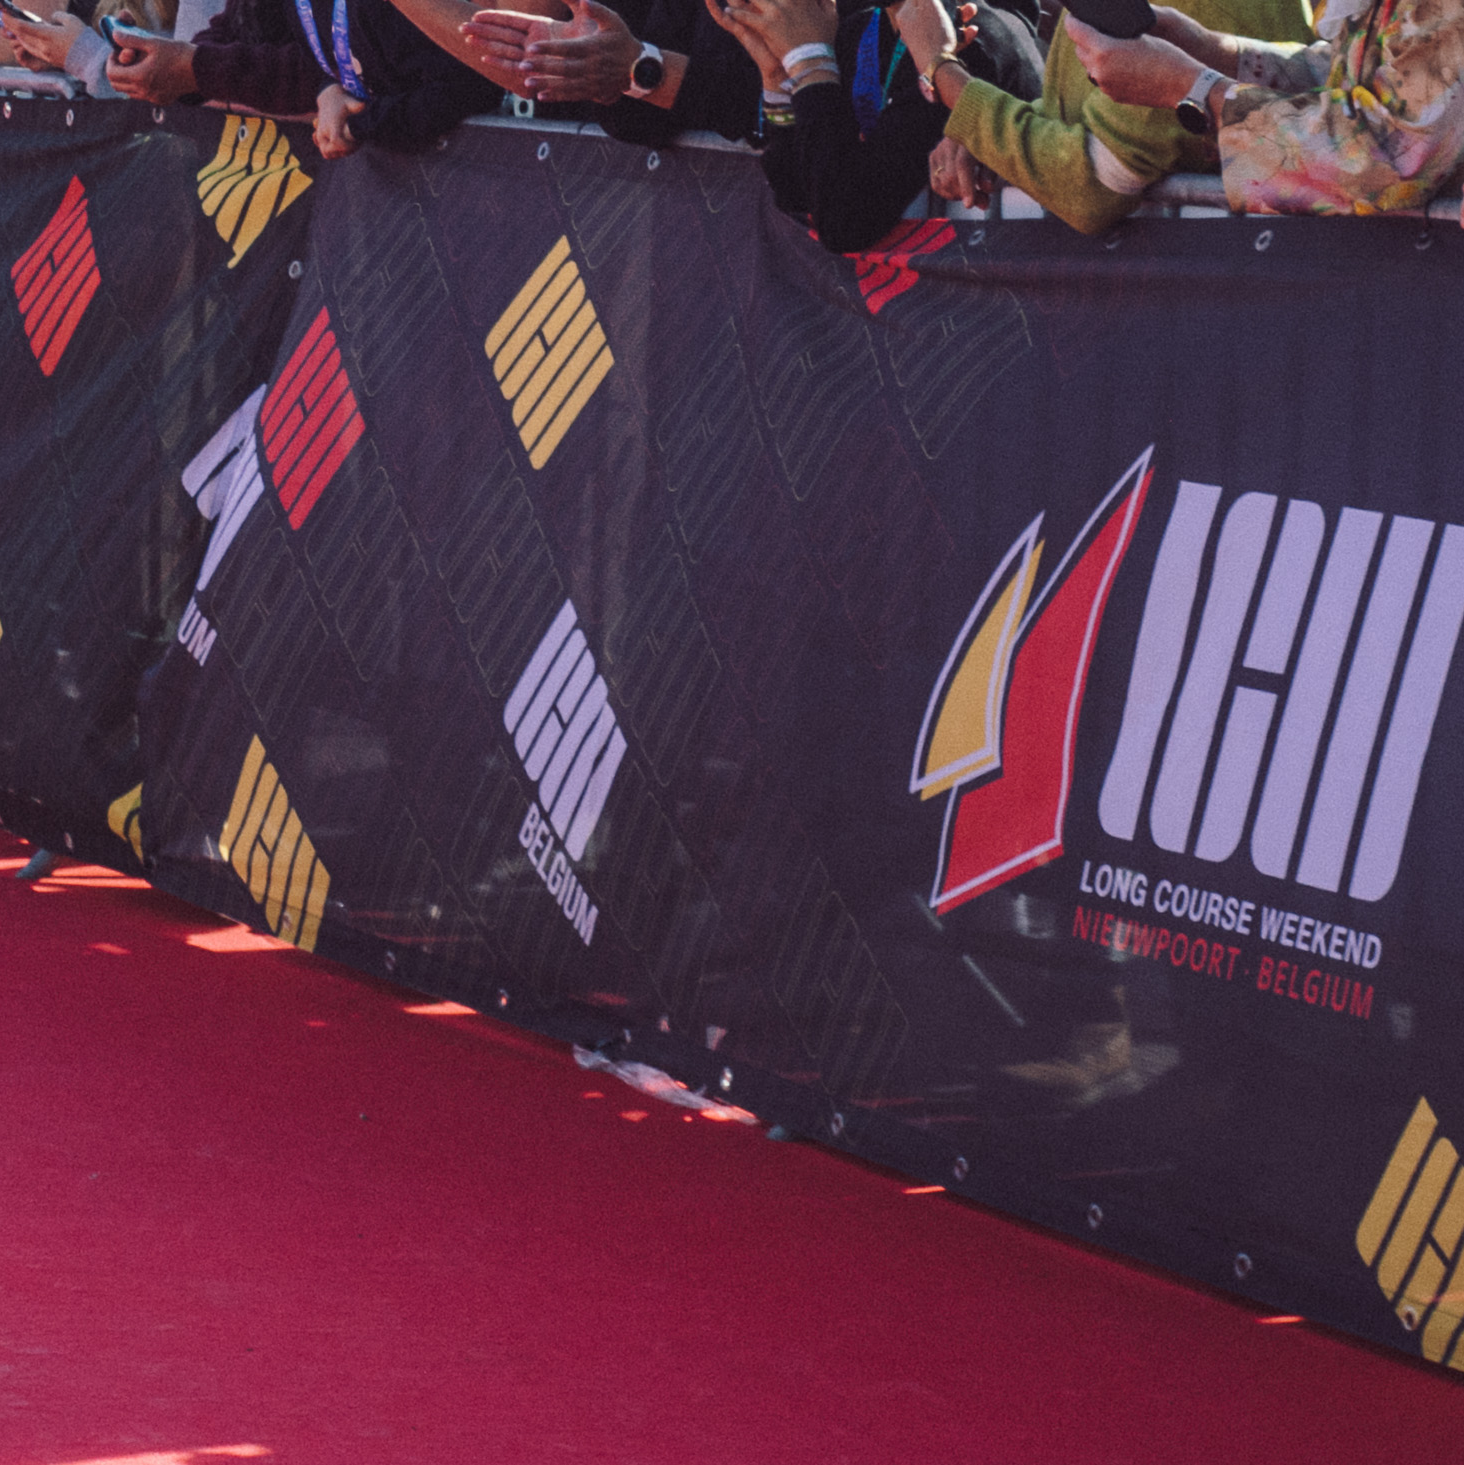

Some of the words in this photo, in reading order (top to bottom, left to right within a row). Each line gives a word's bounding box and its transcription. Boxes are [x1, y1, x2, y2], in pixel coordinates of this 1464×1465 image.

[518, 802, 599, 947] BELGIUM
[1079, 860, 1148, 907] LONG
[1153, 879, 1256, 936] COURSE
[1260, 906, 1382, 970] WEEKEND
[1073, 906, 1242, 981] NIEUWPOORT
[1257, 956, 1375, 1020] BELGIUM
